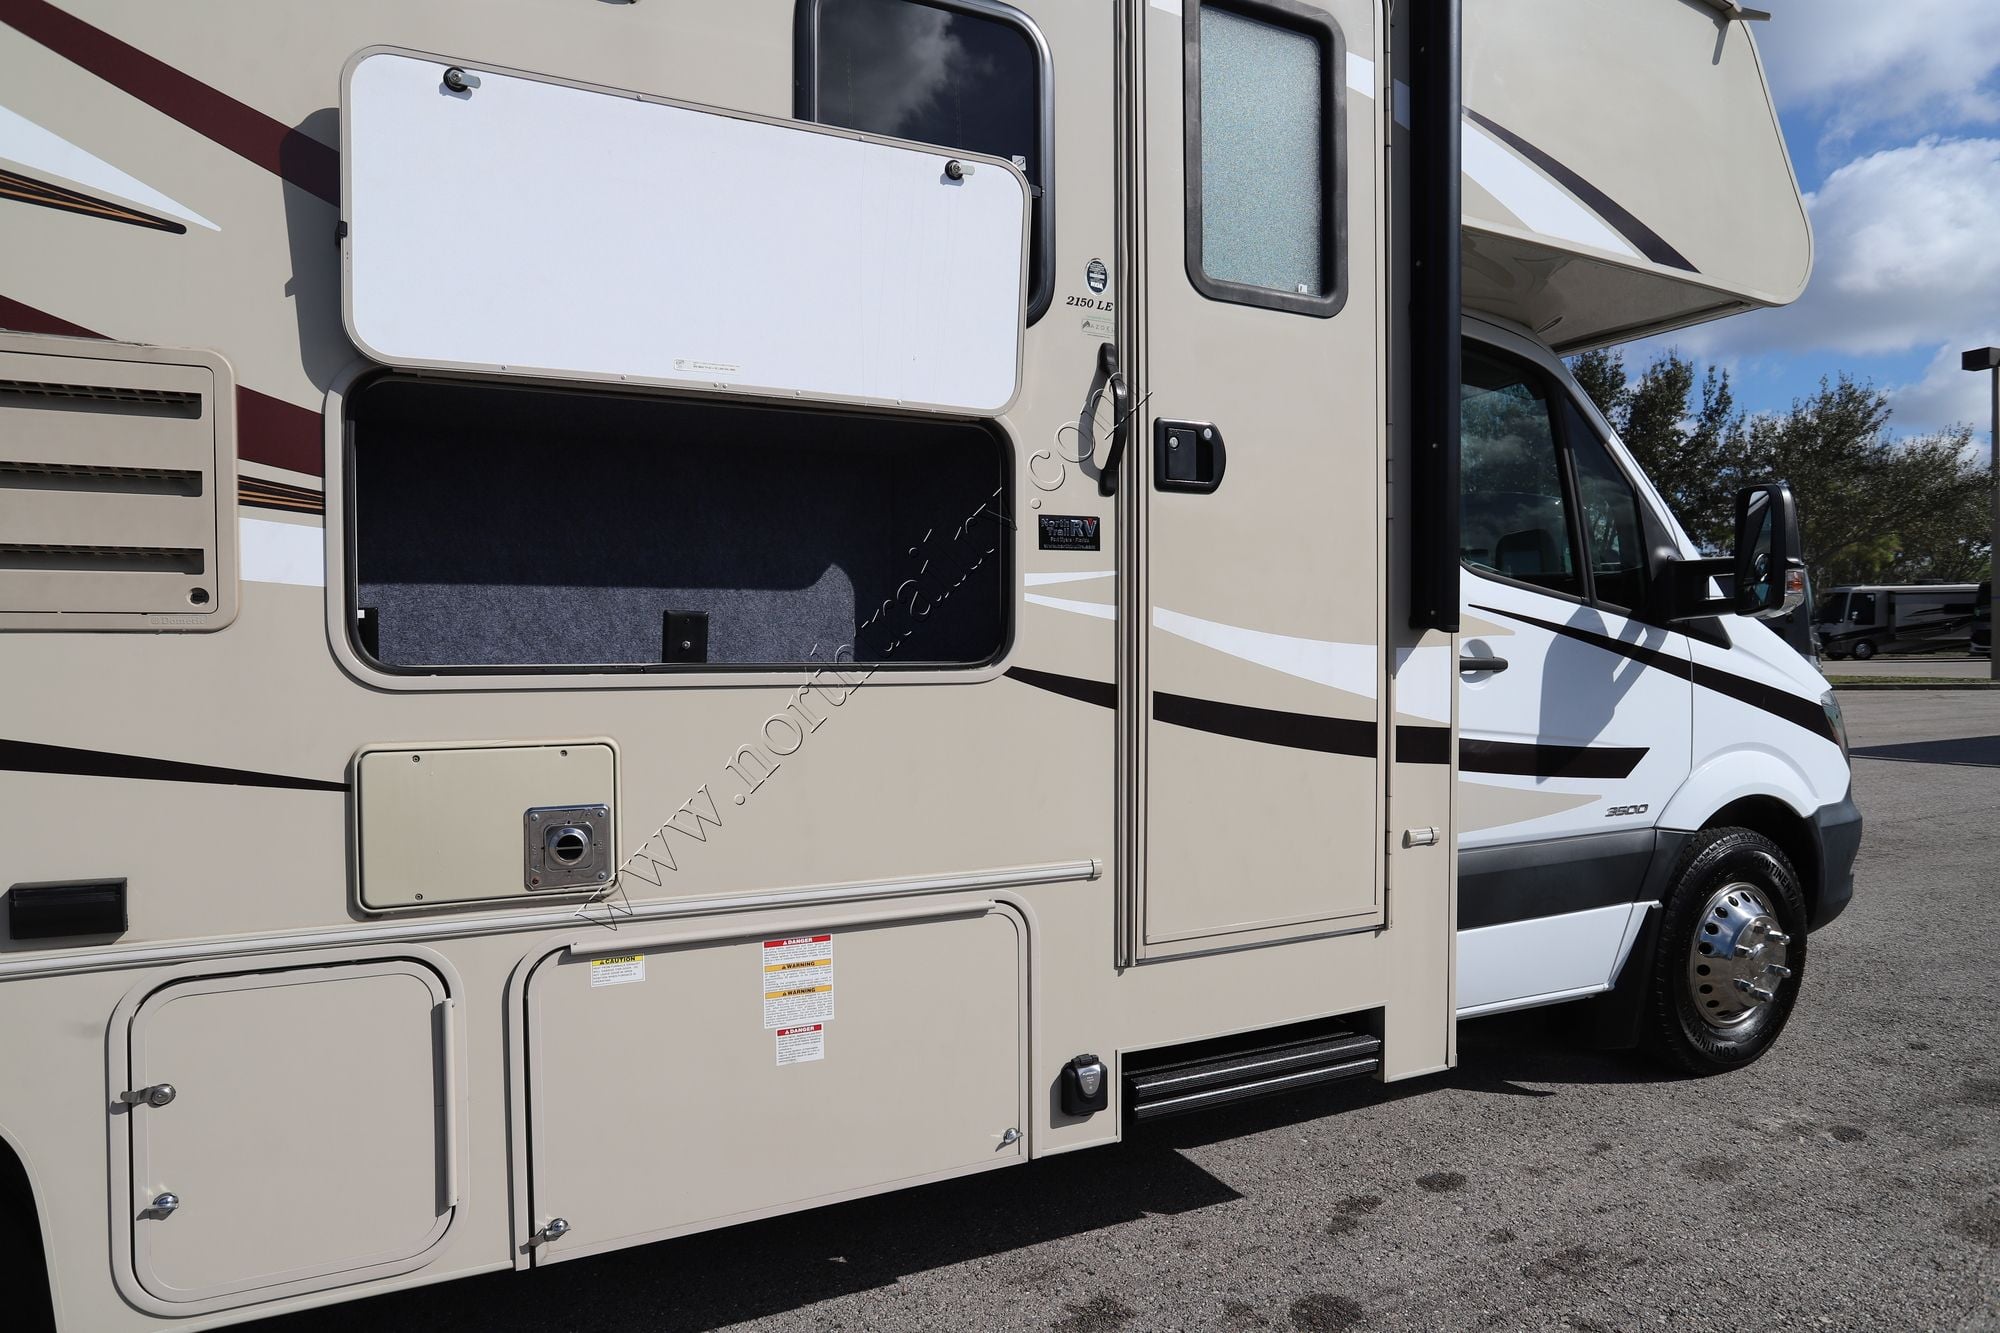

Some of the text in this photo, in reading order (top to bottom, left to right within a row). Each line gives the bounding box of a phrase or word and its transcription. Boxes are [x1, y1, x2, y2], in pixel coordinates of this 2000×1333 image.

[1066, 295, 1114, 312] 2150 LE
[1041, 517, 1097, 537] North RV
[1046, 526, 1070, 537] Trail
[1605, 804, 1649, 817] 3500
[788, 937, 813, 945] DANGER
[605, 956, 636, 965] CAUTION
[786, 961, 815, 969] WARNING
[787, 987, 816, 996] WARNING
[790, 1026, 815, 1034] DANGER
